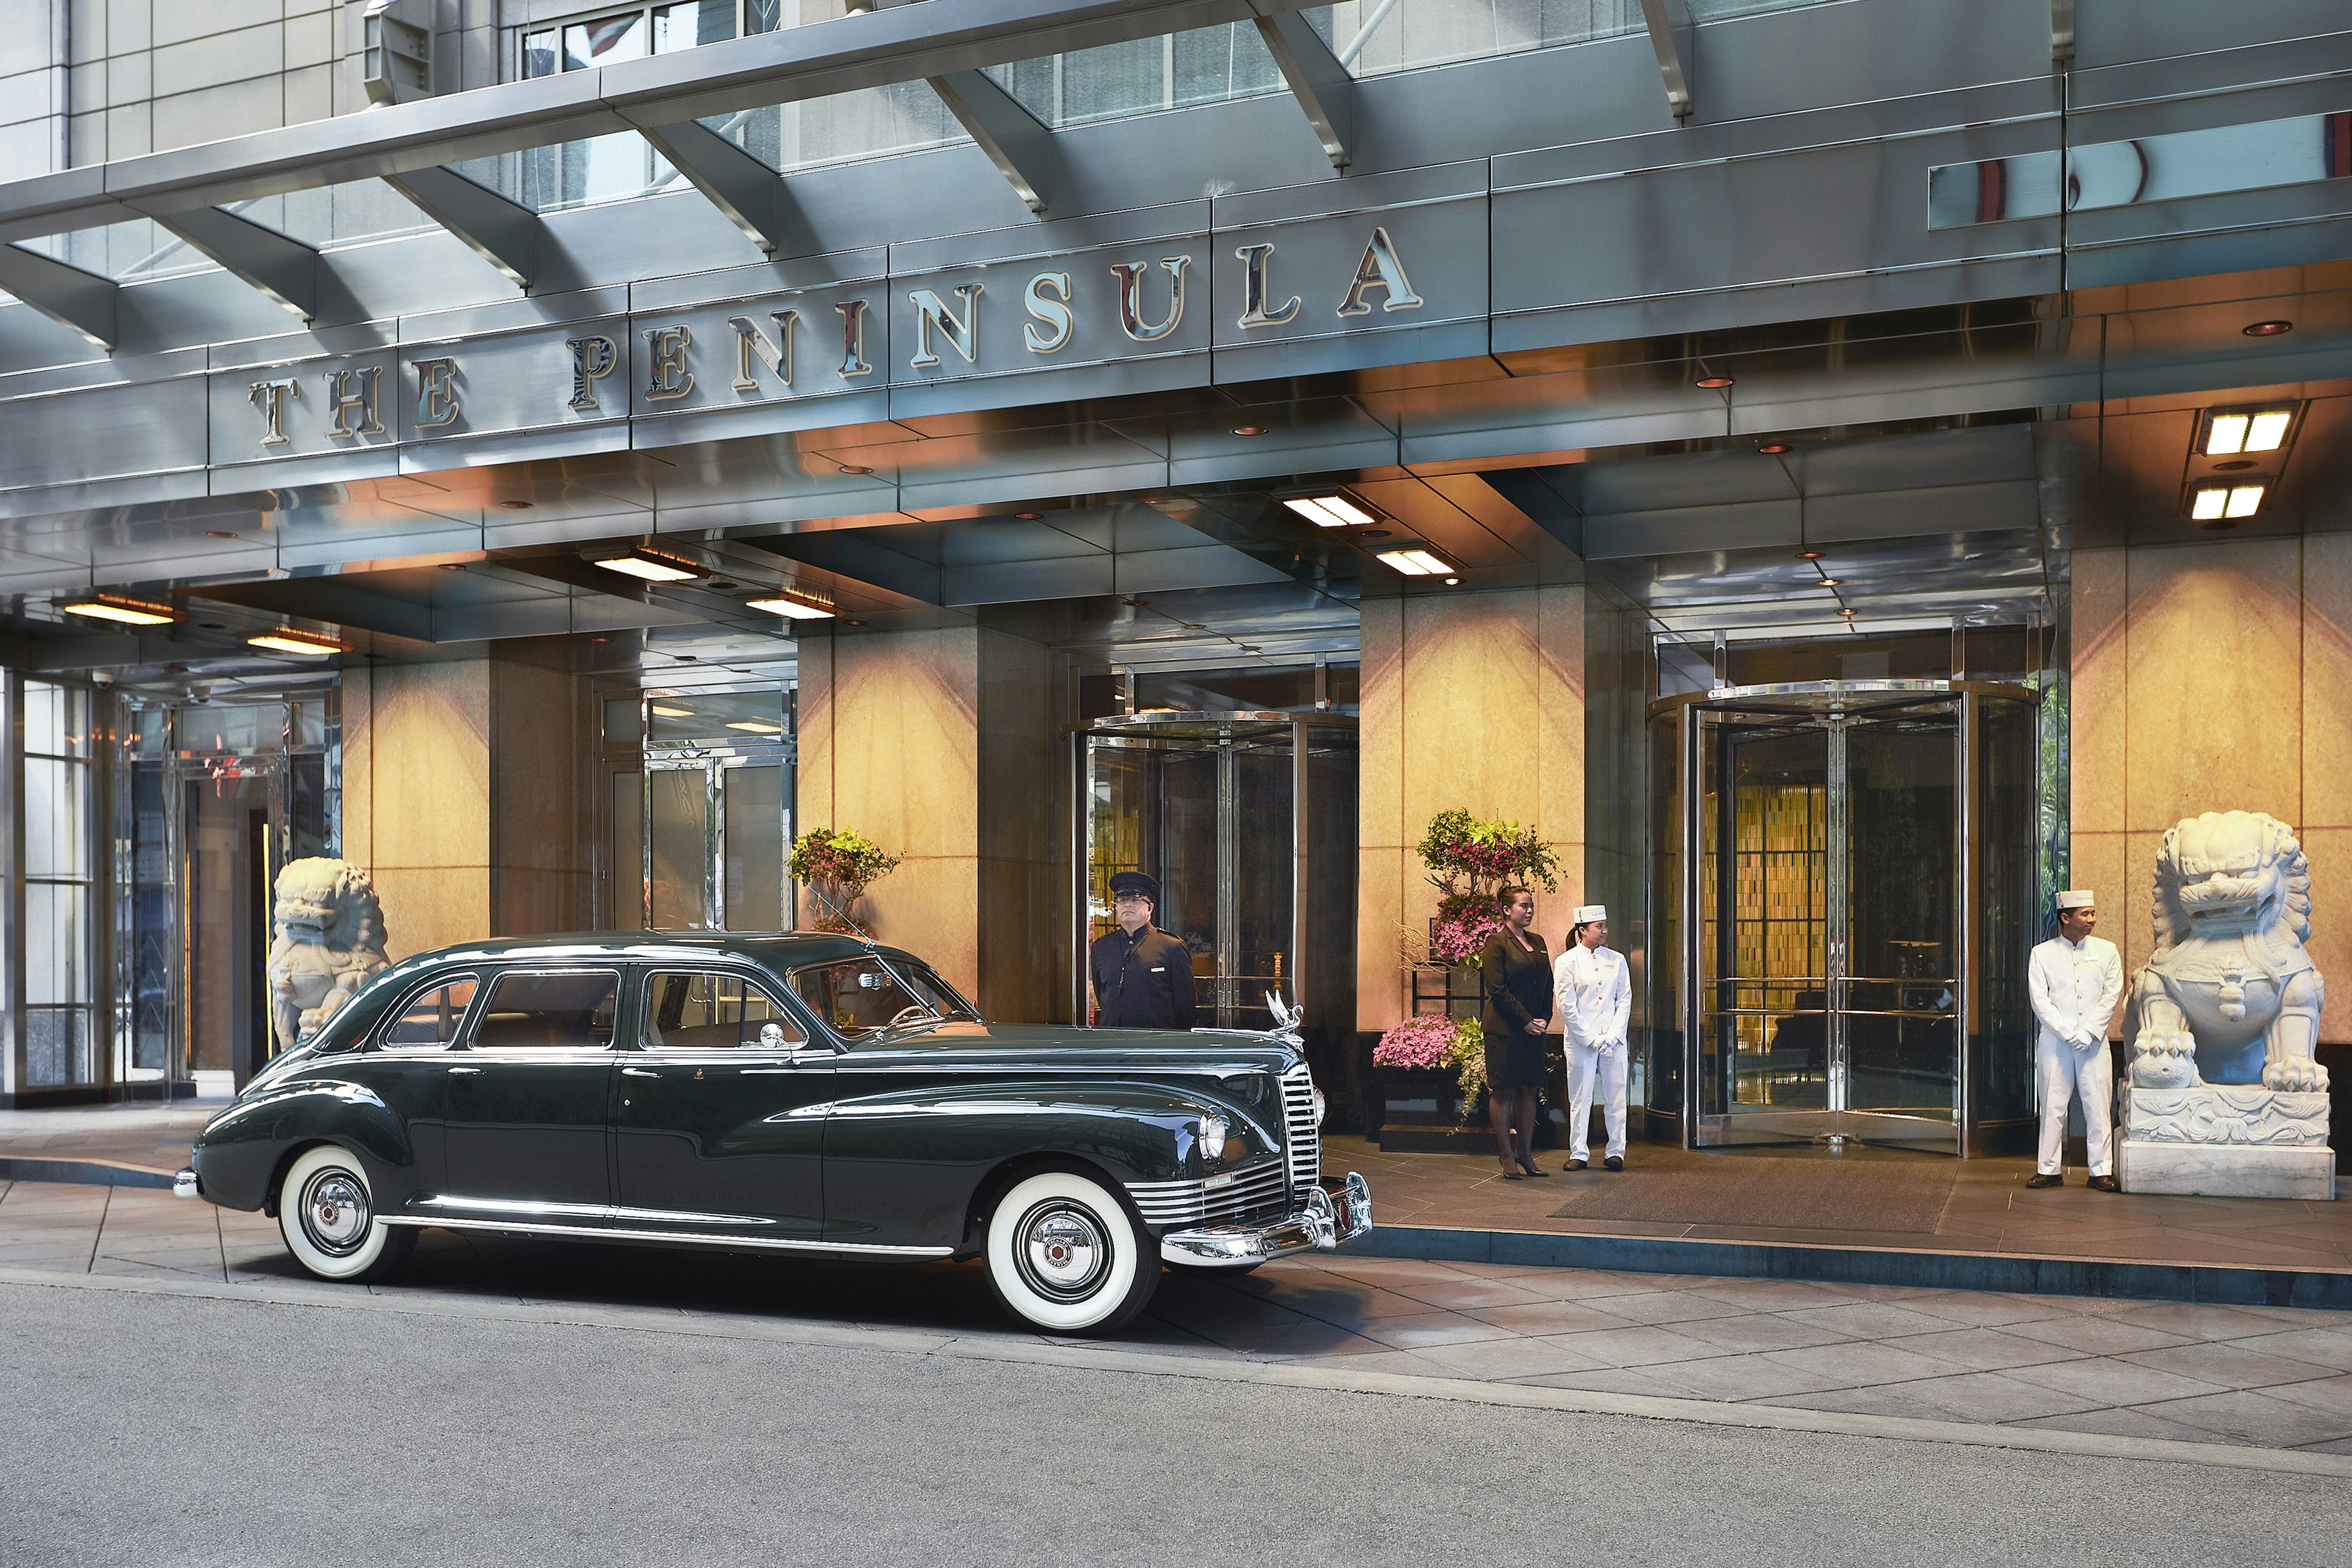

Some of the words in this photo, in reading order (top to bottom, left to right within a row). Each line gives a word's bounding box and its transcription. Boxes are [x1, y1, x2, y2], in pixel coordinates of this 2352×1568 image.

[249, 357, 459, 447] THE
[567, 226, 1423, 410] PENINSULA
[1047, 1239, 1068, 1248] PACKARD
[1048, 1258, 1068, 1267] PACKARD
